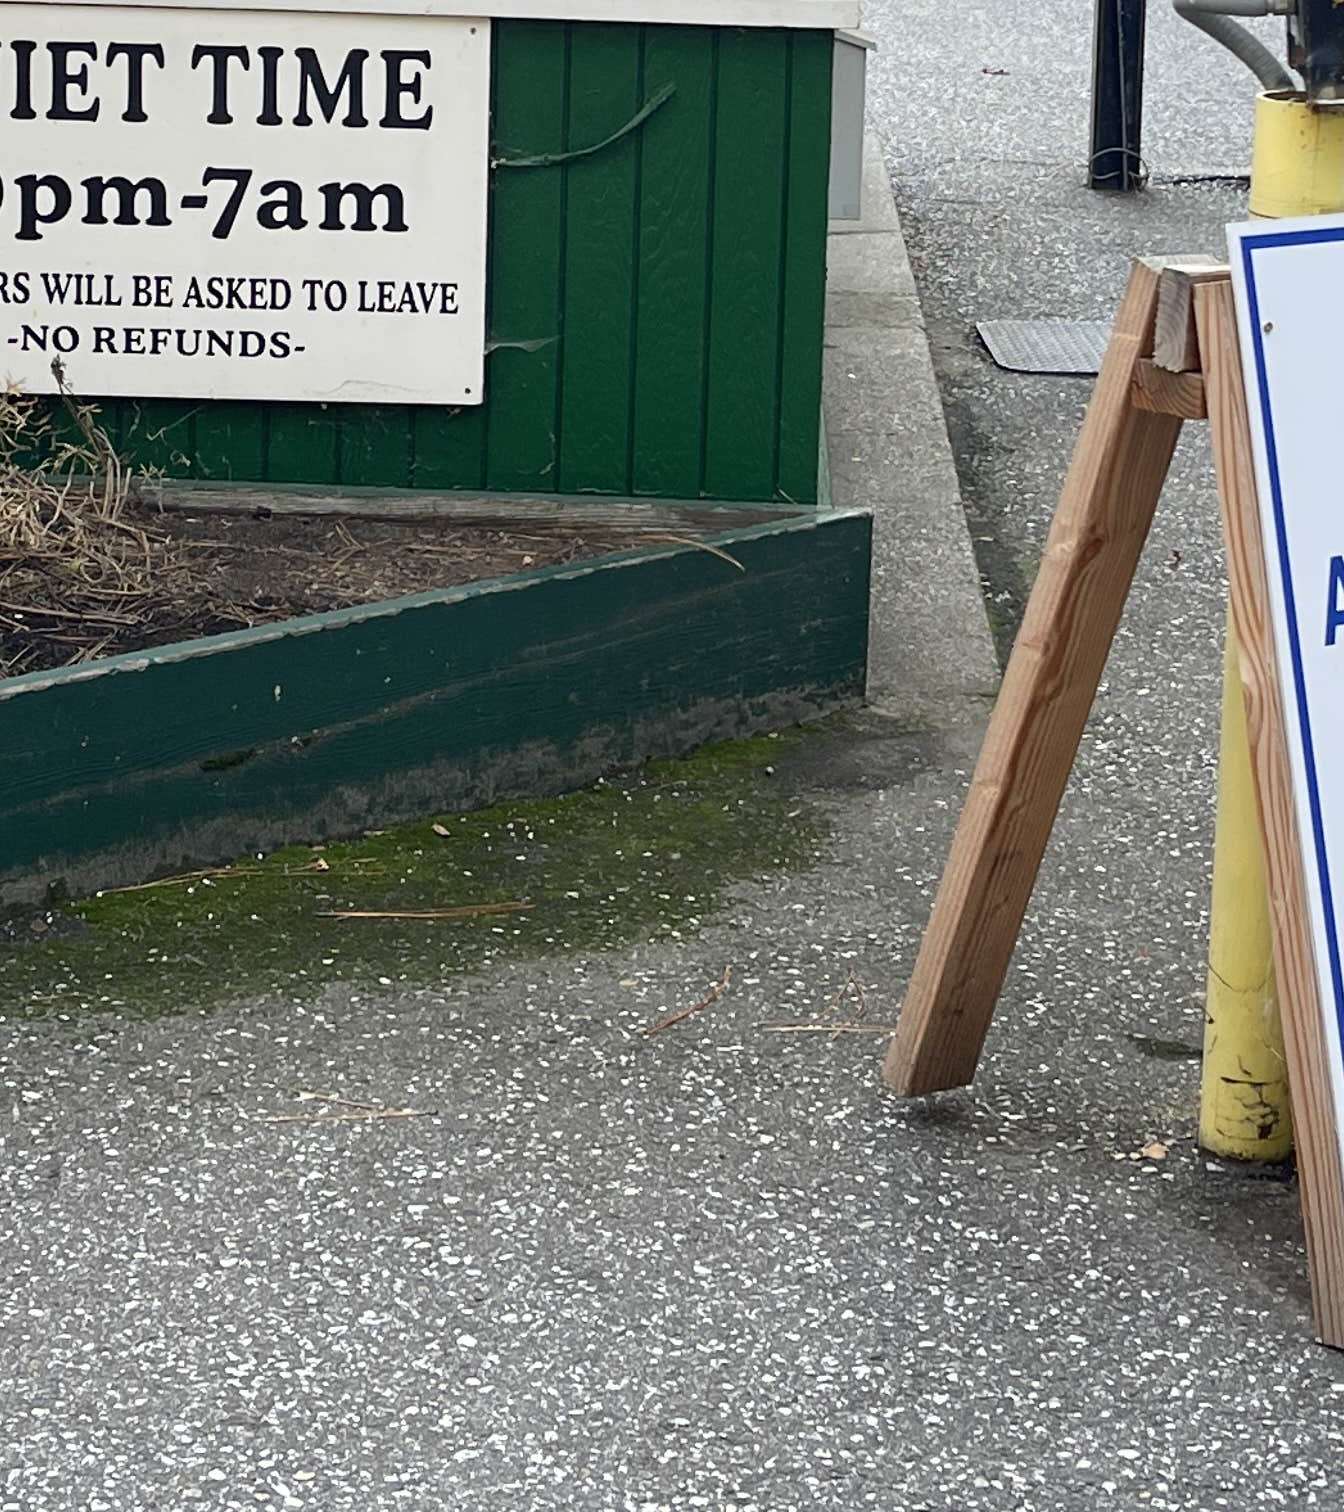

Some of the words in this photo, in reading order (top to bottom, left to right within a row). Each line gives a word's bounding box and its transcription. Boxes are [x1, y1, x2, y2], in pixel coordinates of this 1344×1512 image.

[190, 42, 435, 132] TIME
[39, 272, 123, 307] WILL
[131, 275, 174, 308] BE
[181, 276, 292, 311] ASKED
[301, 279, 347, 312] TO
[357, 280, 460, 315] LEAVE
